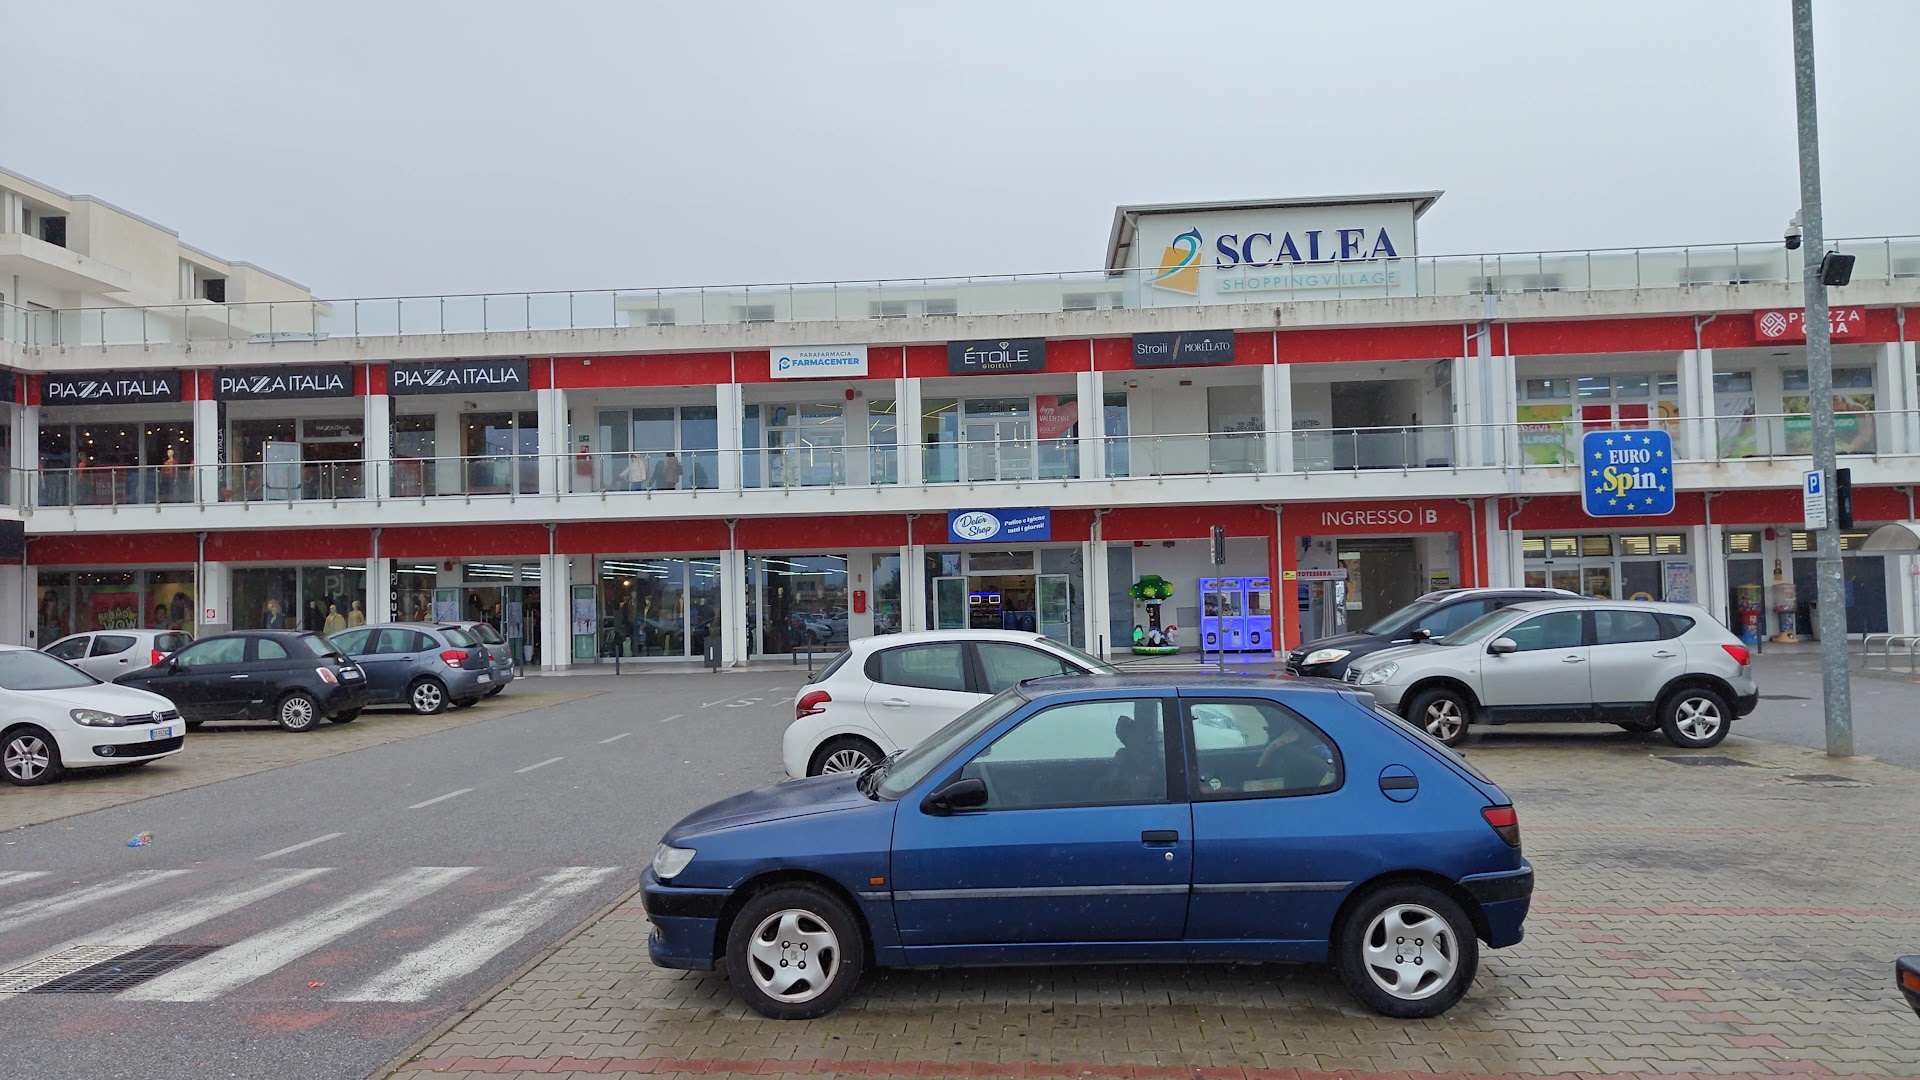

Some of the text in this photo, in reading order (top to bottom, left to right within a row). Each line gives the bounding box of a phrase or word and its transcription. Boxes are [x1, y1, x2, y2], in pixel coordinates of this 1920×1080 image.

[1216, 227, 1398, 269] SCALEA
[964, 347, 1029, 364] ÉTOILE
[1137, 342, 1230, 354] Stroili MORELLATO
[792, 358, 859, 366] FARMACENTER
[221, 374, 344, 393] PIAZZA ITALIA
[394, 367, 519, 386] PIAZZA ITALIA
[49, 380, 170, 398] PIAZZA ITALIA
[1039, 405, 1055, 415] Happy
[1609, 449, 1651, 464] EURO
[1603, 466, 1657, 497] Spin
[1810, 475, 1817, 491] P
[960, 515, 987, 528] Deter
[1004, 517, 1022, 526] Pulito
[1027, 515, 1045, 524] Igiene
[1321, 510, 1438, 525] INGRESSO B
[968, 526, 992, 537] Shop
[98, 609, 130, 621] PROMO
